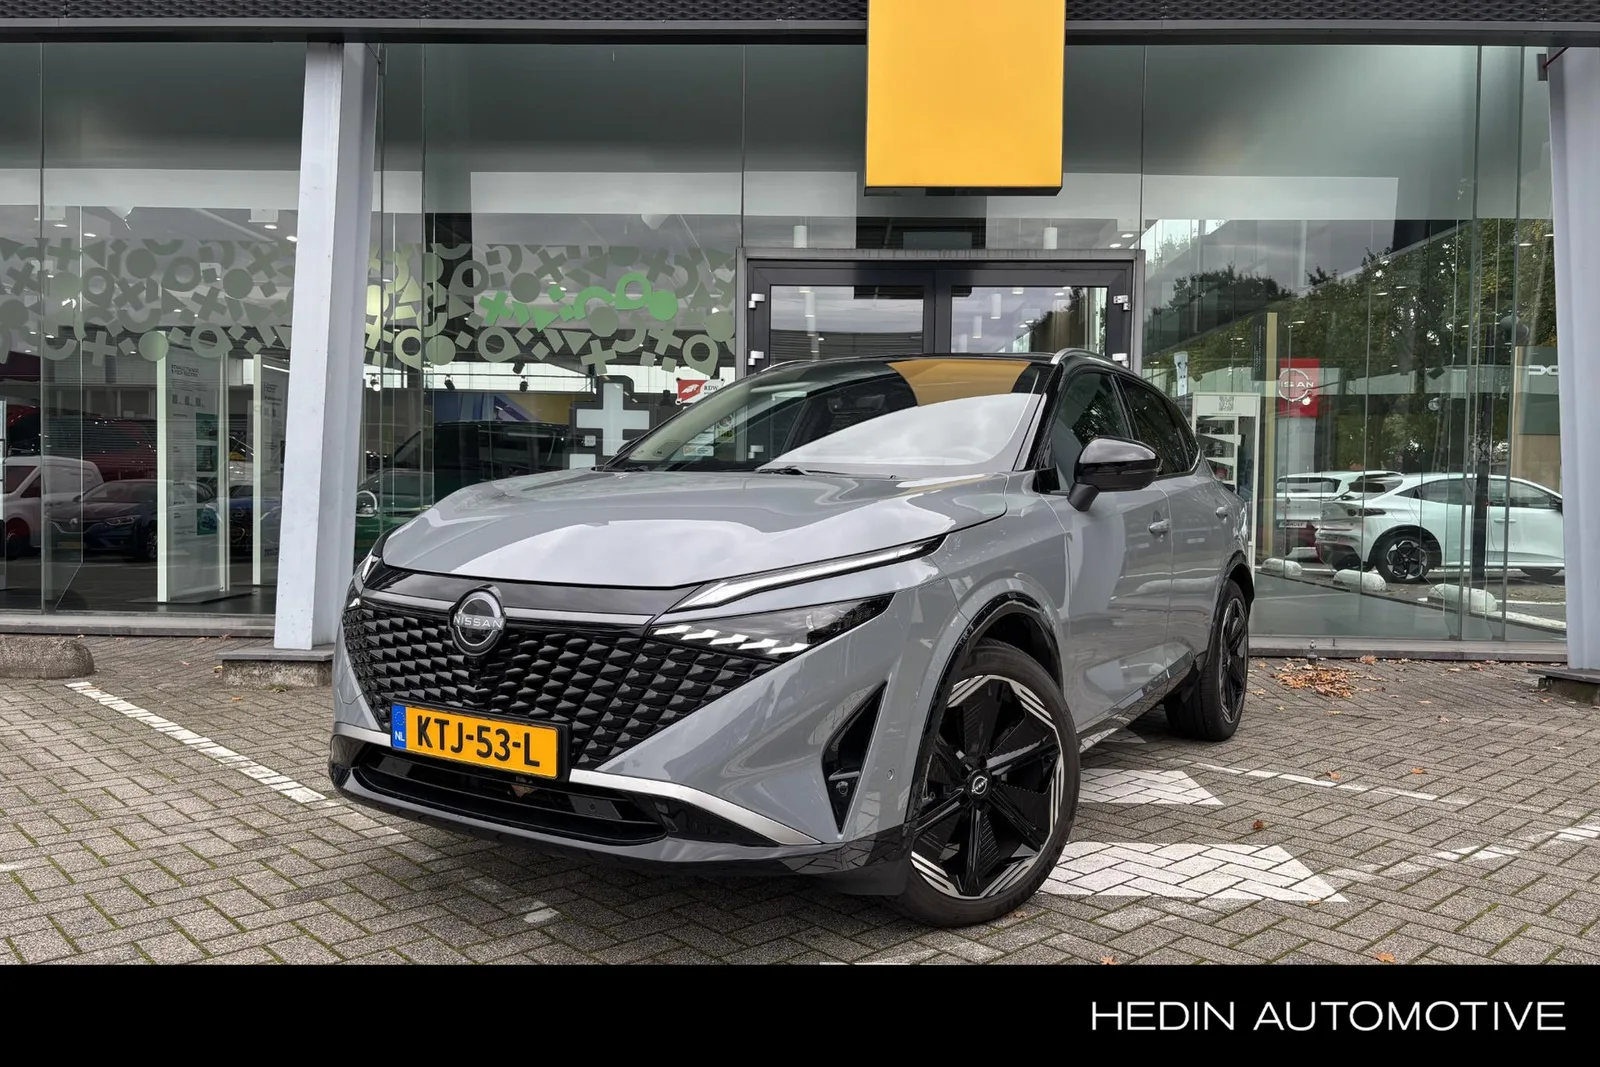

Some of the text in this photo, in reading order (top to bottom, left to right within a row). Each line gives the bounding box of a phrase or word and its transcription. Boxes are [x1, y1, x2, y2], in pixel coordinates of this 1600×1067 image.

[453, 615, 503, 628] NISSAN
[394, 731, 405, 742] NL
[417, 715, 540, 767] KTJ-53-L
